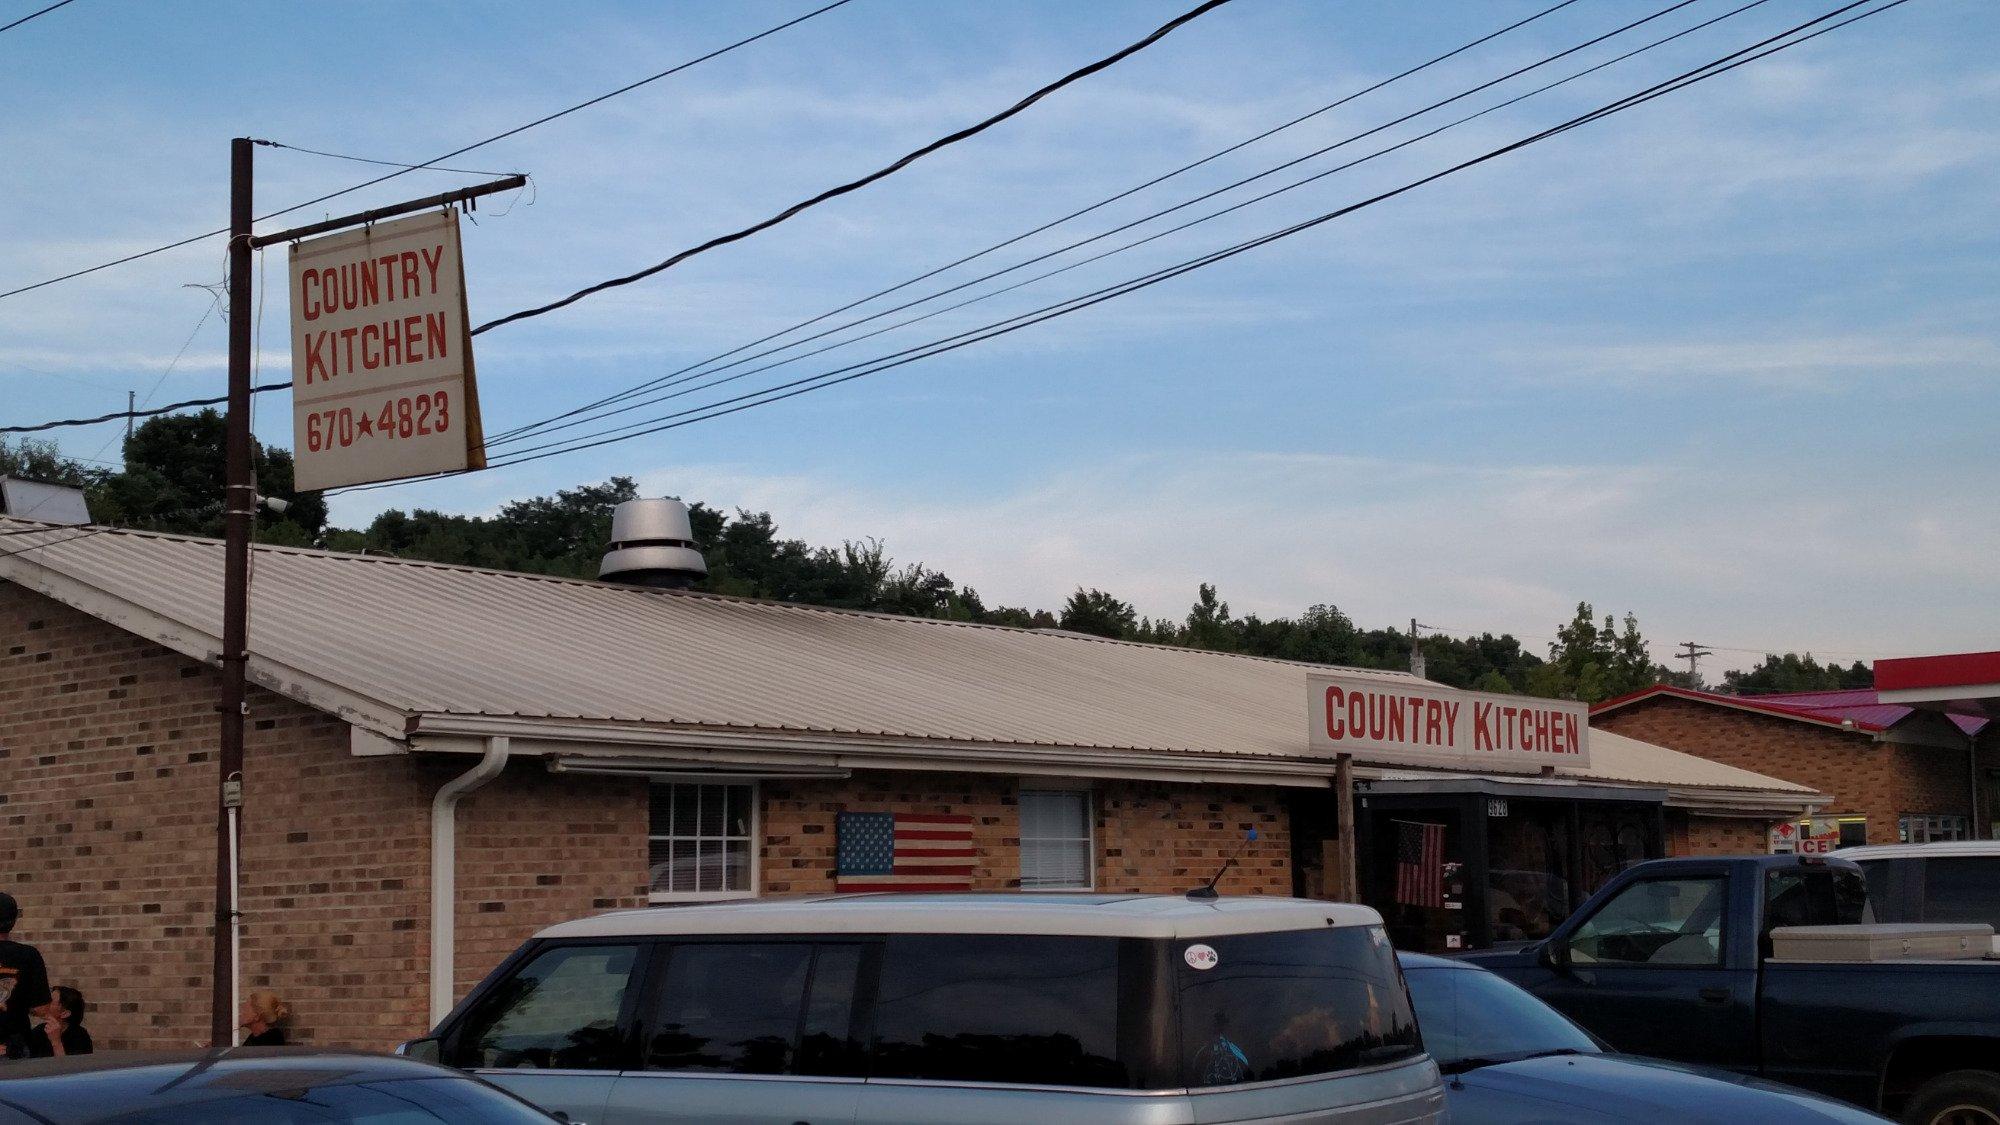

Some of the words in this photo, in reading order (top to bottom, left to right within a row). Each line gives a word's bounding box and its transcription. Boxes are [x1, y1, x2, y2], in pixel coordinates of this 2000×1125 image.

[302, 245, 444, 322] COUNTRY
[304, 311, 447, 385] KITCHEN
[1325, 686, 1460, 747] COUNTRY
[1474, 701, 1580, 755] KITCHEN
[1795, 840, 1828, 853] ICE
